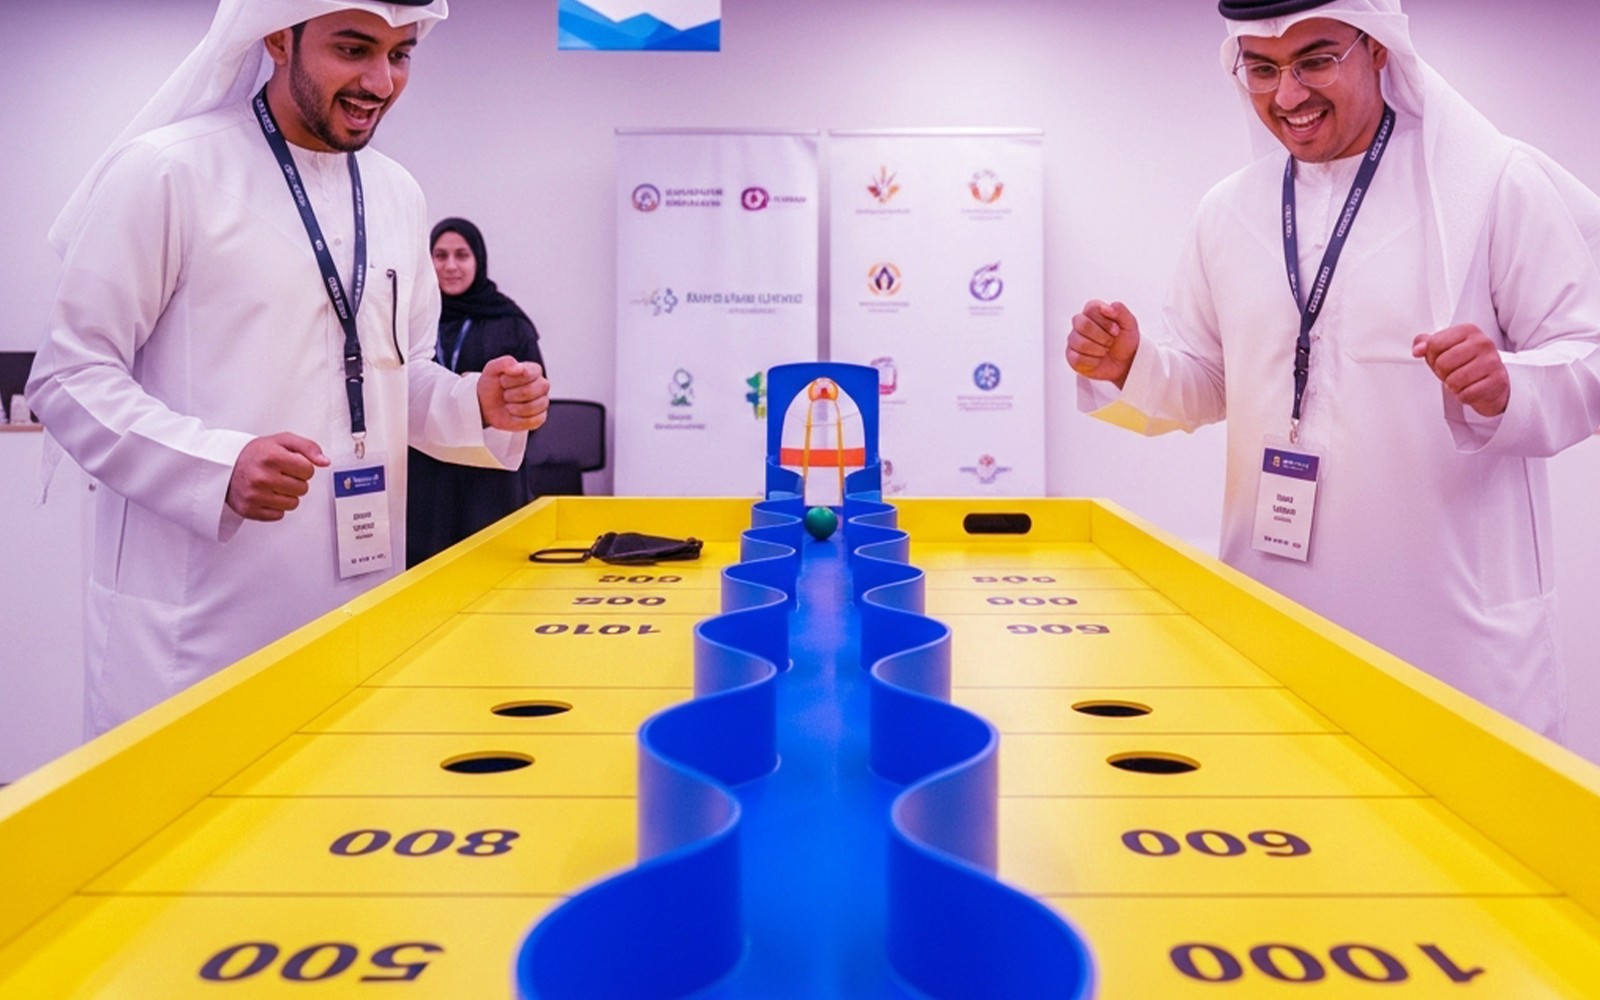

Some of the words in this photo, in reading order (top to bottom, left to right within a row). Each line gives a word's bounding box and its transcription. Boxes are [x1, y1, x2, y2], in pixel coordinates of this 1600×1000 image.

[534, 623, 661, 635] 1010
[328, 828, 521, 858] 800
[1120, 829, 1312, 858] 600
[197, 941, 446, 984] 500
[1168, 942, 1485, 985] 1000
